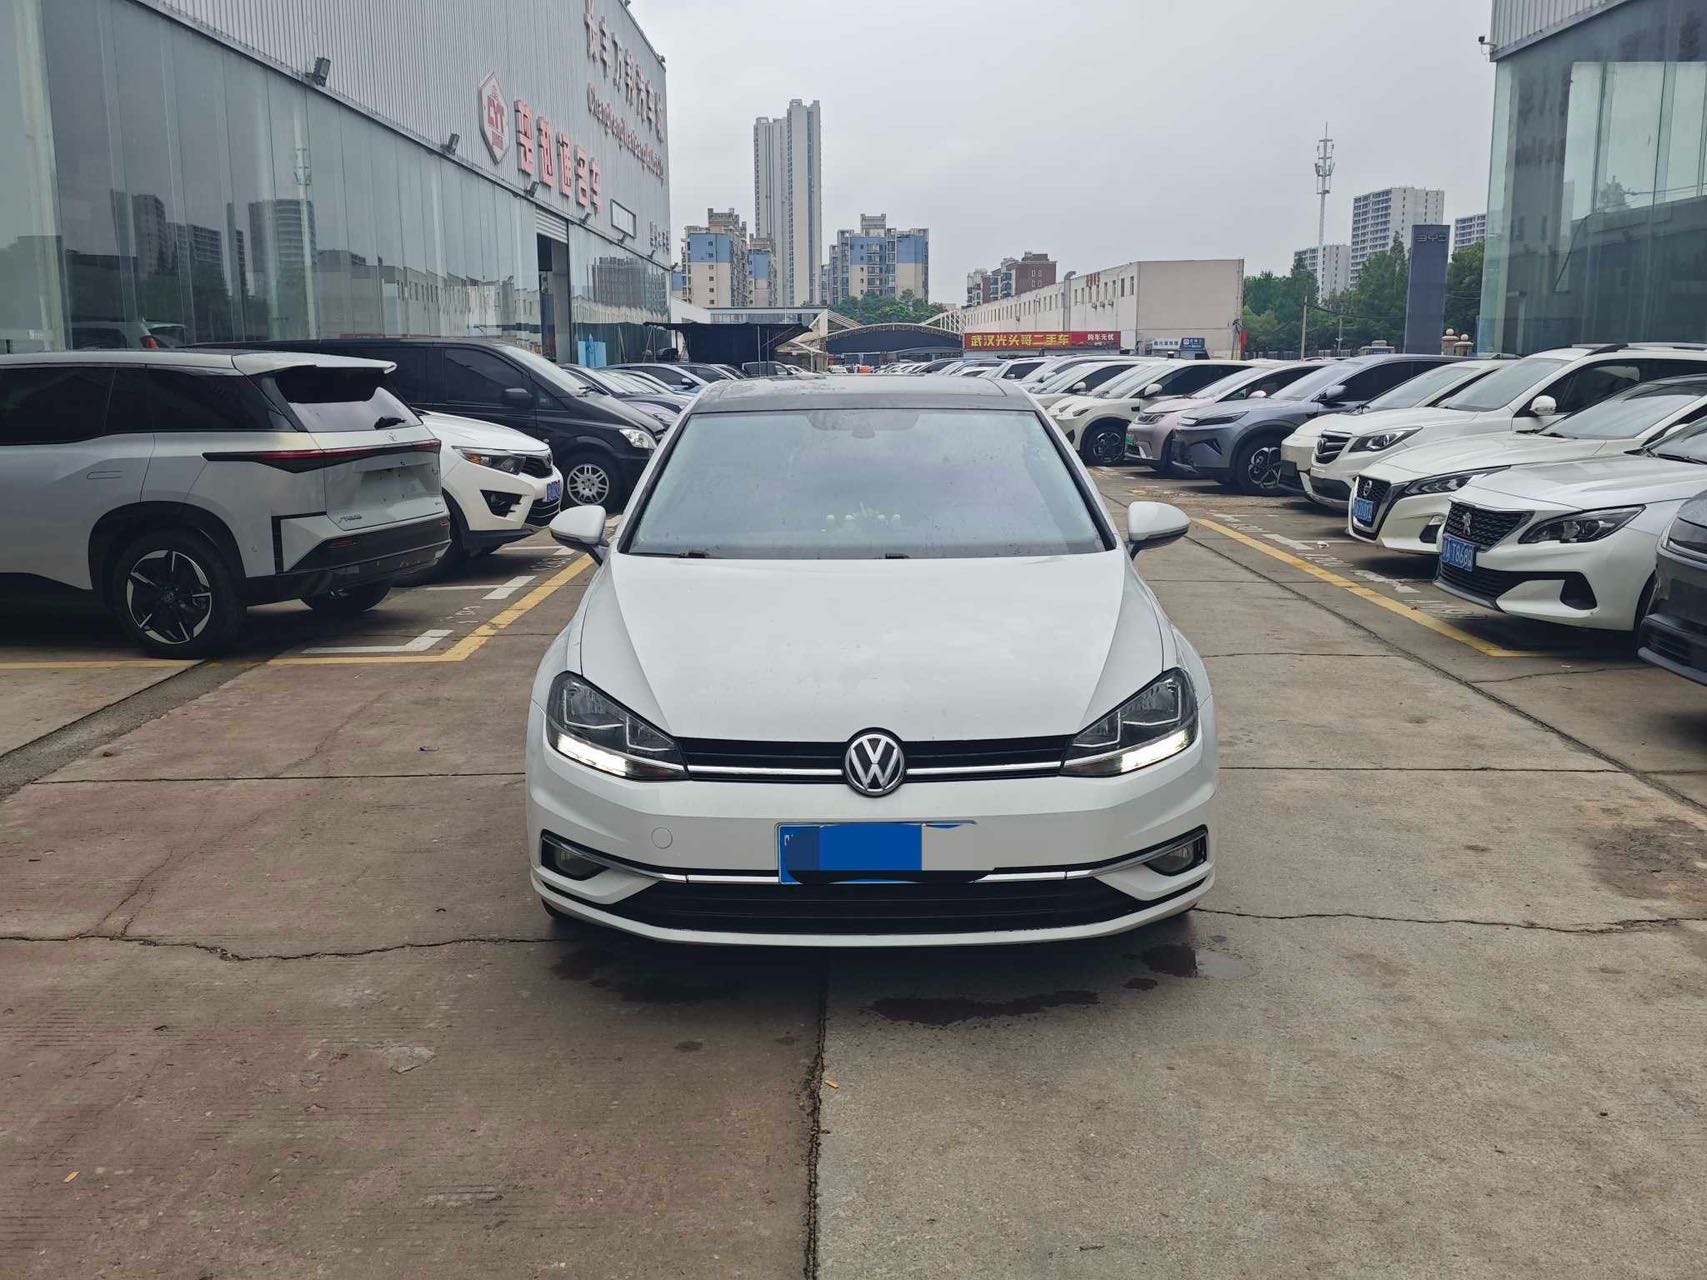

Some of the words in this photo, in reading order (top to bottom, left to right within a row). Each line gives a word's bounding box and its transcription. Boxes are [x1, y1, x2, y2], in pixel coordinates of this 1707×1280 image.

[970, 334, 1070, 347] 武汉光头哥二手车
[1087, 333, 1115, 342] 购车无忧
